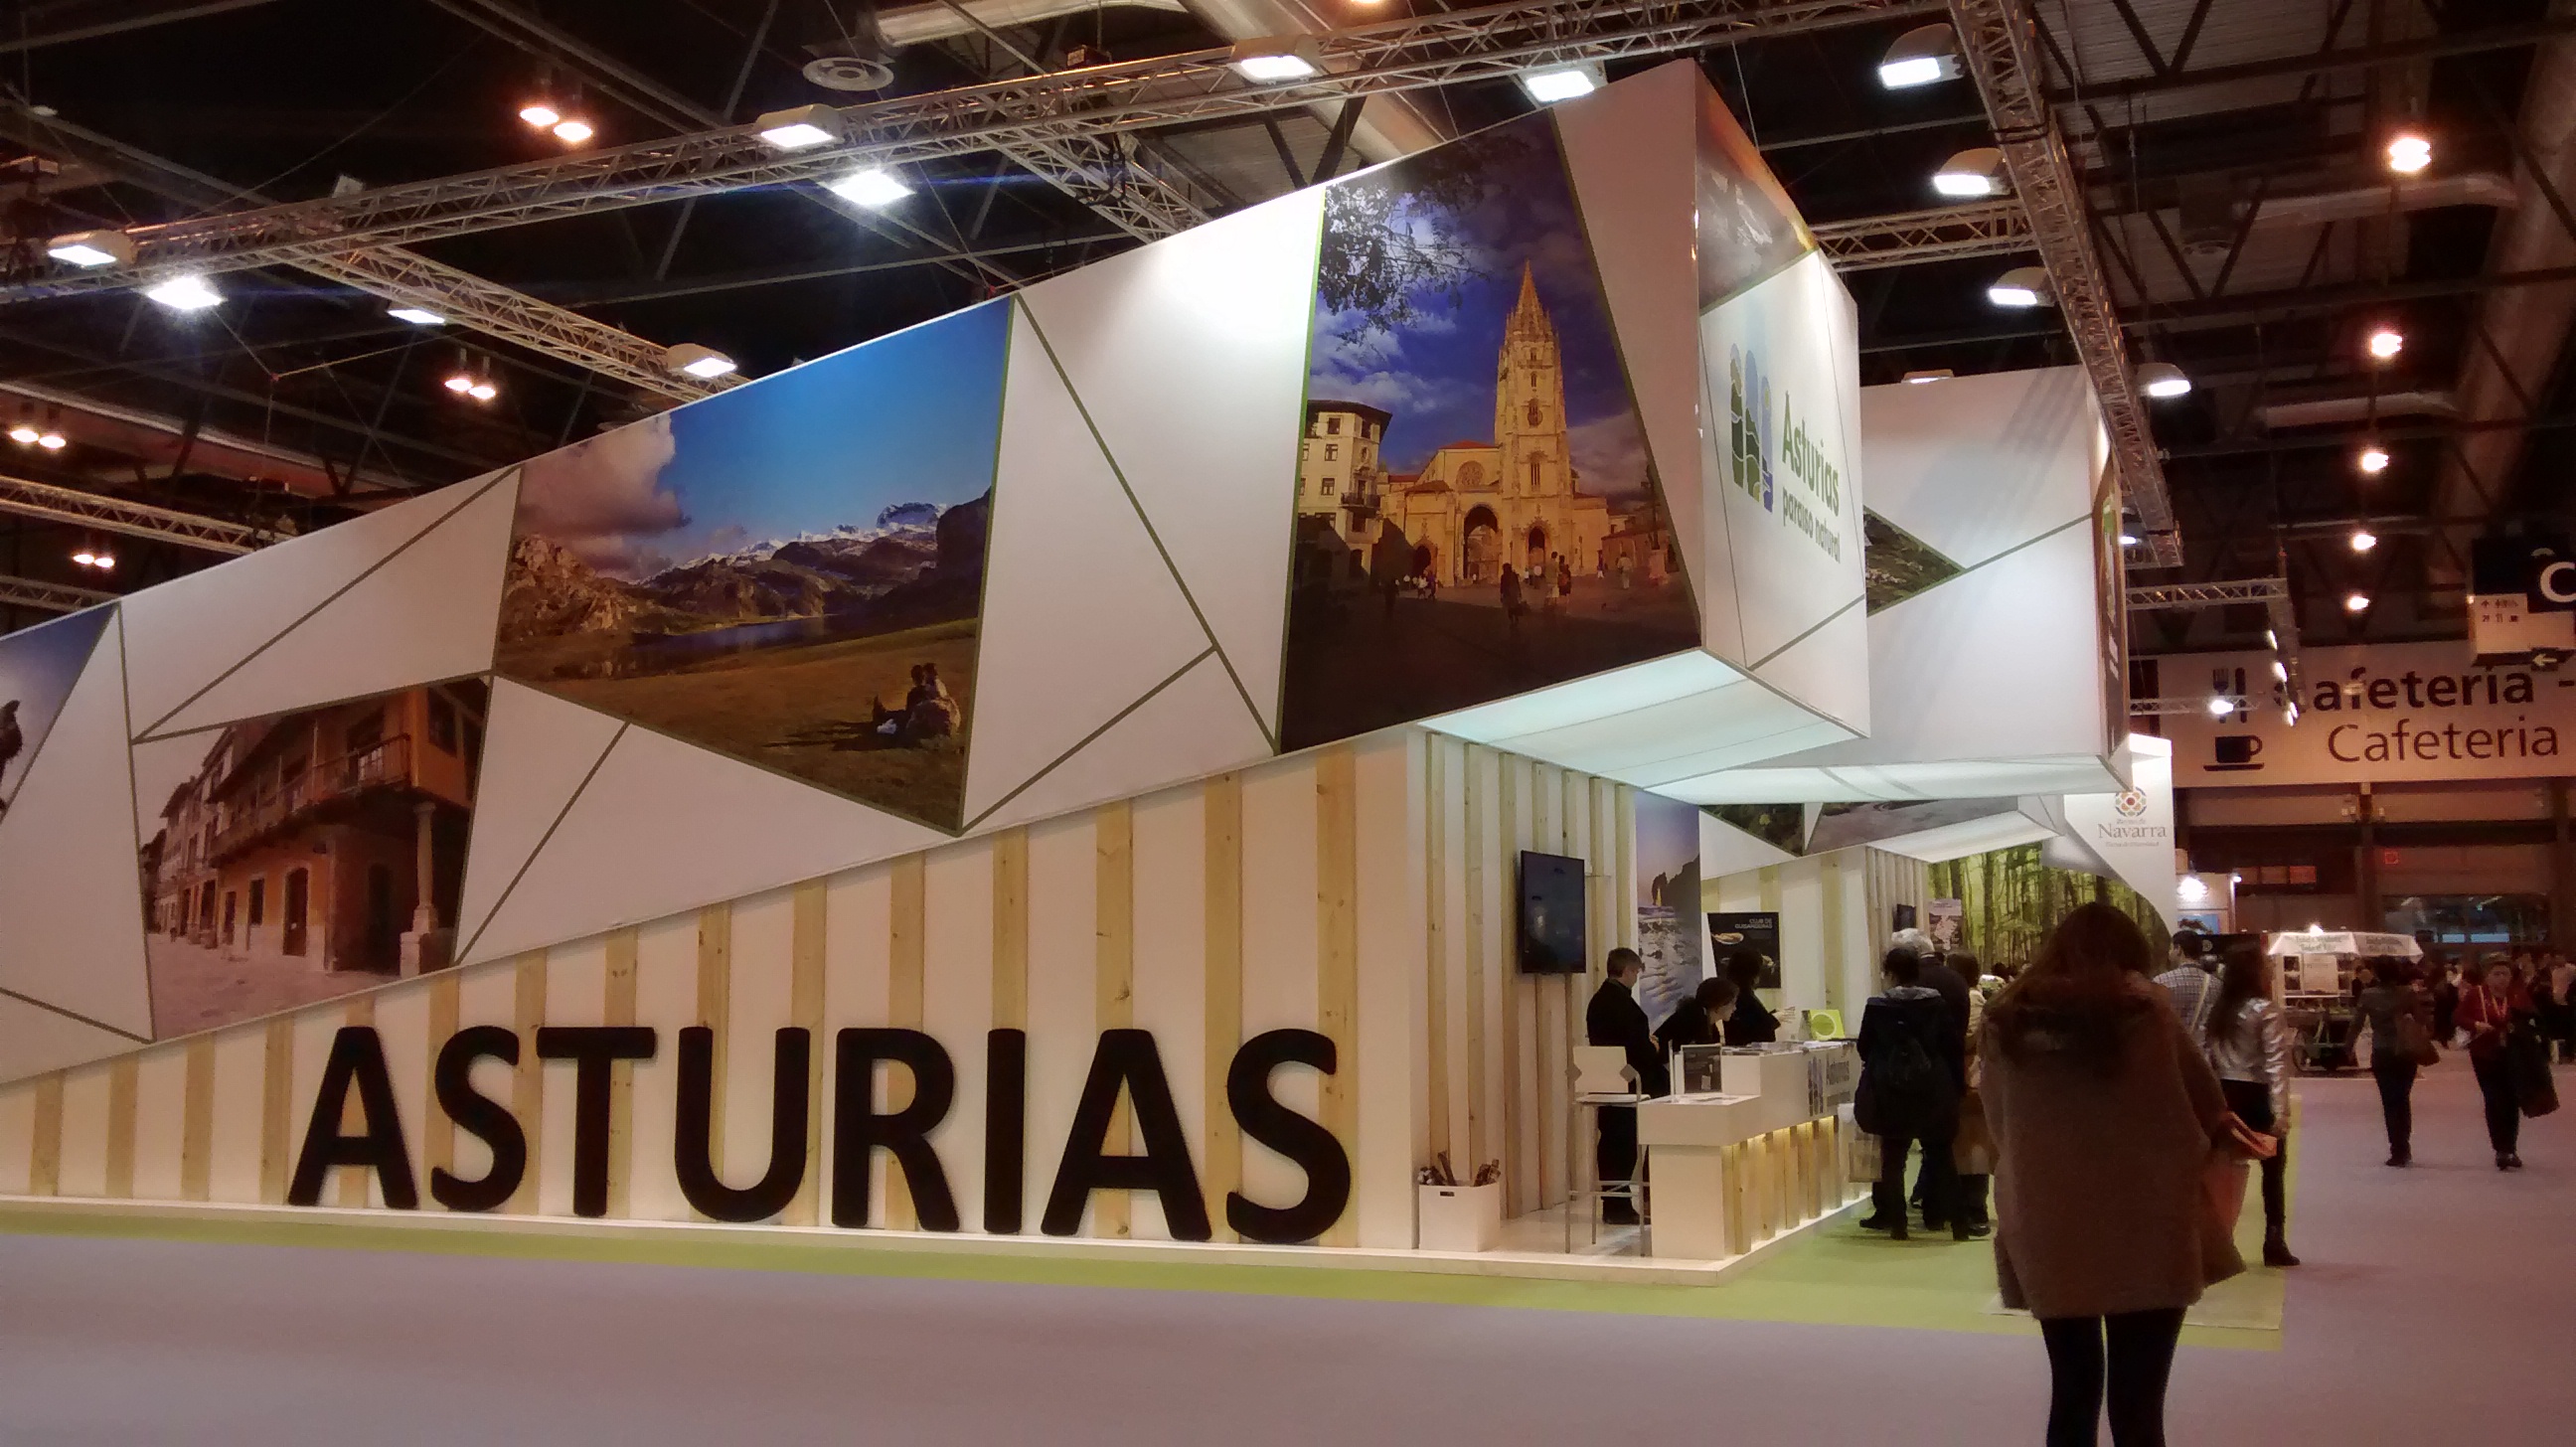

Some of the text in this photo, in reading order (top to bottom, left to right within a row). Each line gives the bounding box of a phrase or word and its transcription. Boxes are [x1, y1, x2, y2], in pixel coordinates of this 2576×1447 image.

[1782, 390, 1840, 517] Asturias
[1815, 516, 1841, 563] natural
[2274, 666, 2534, 712] afetería
[2328, 715, 2559, 762] Cafeteria
[2097, 823, 2168, 839] Navarra
[287, 1027, 1352, 1243] ASTURIAS
